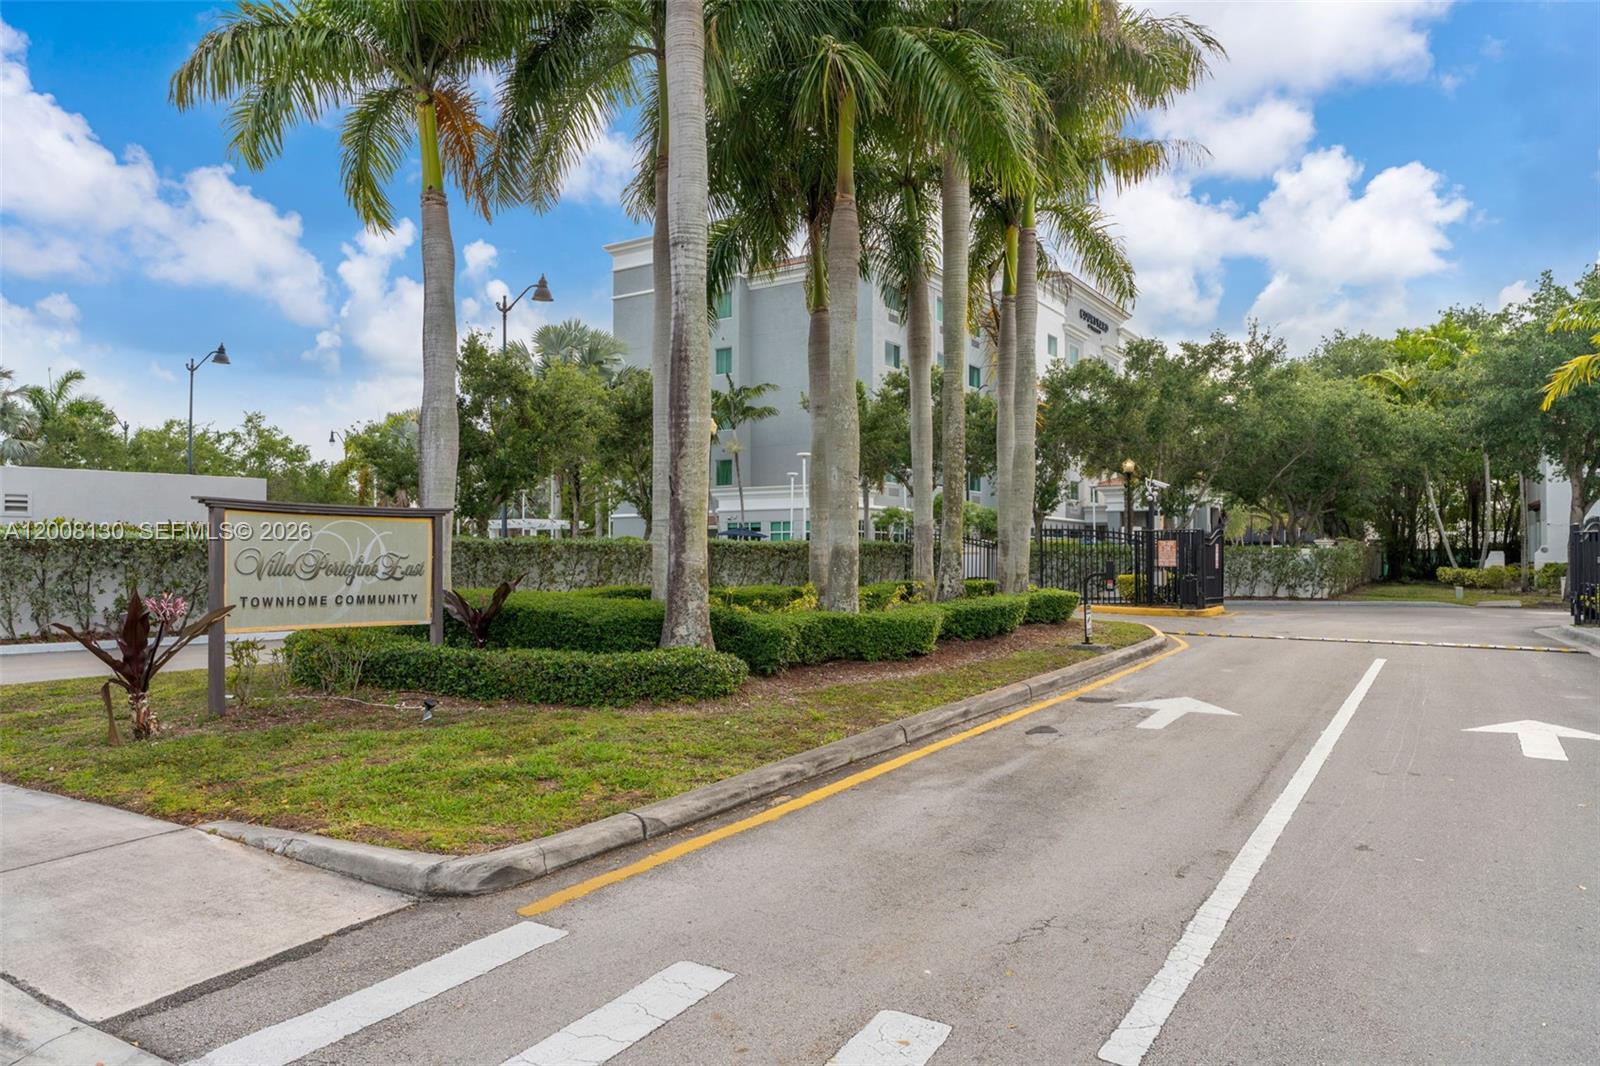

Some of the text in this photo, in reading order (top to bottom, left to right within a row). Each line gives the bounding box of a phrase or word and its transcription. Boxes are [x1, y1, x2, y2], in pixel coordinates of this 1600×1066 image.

[234, 548, 295, 581] Villa
[375, 552, 425, 581] East
[240, 594, 418, 608] TOWNHOME COMMUNITY
